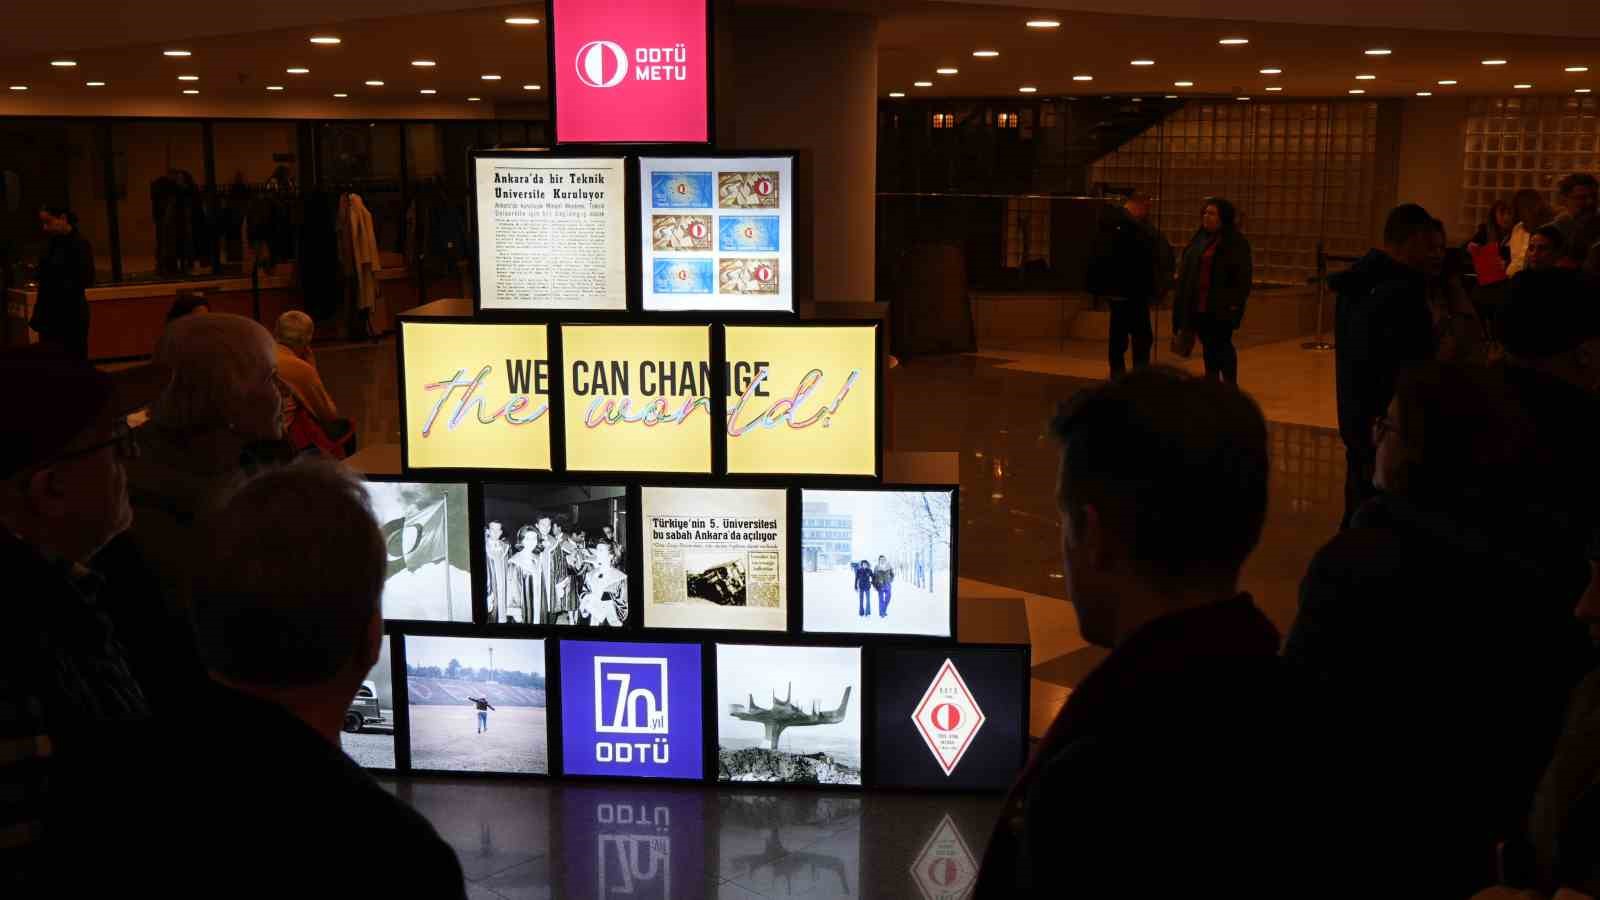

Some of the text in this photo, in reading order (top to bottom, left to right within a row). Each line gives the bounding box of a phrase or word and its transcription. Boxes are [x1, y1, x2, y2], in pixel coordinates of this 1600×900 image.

[635, 43, 686, 63] ODTÜ
[635, 66, 686, 81] METU
[494, 173, 605, 184] Ankara'da bir Teknik
[553, 188, 605, 202] Kuruluyor
[506, 359, 770, 397] WE CAN CHANGE
[422, 364, 549, 438] the
[652, 518, 777, 530] Türkiye'nin 5. Üniversitesi
[652, 530, 777, 542] bu sabah Ankara'da açılıyor
[595, 737, 669, 764] ODTÜ
